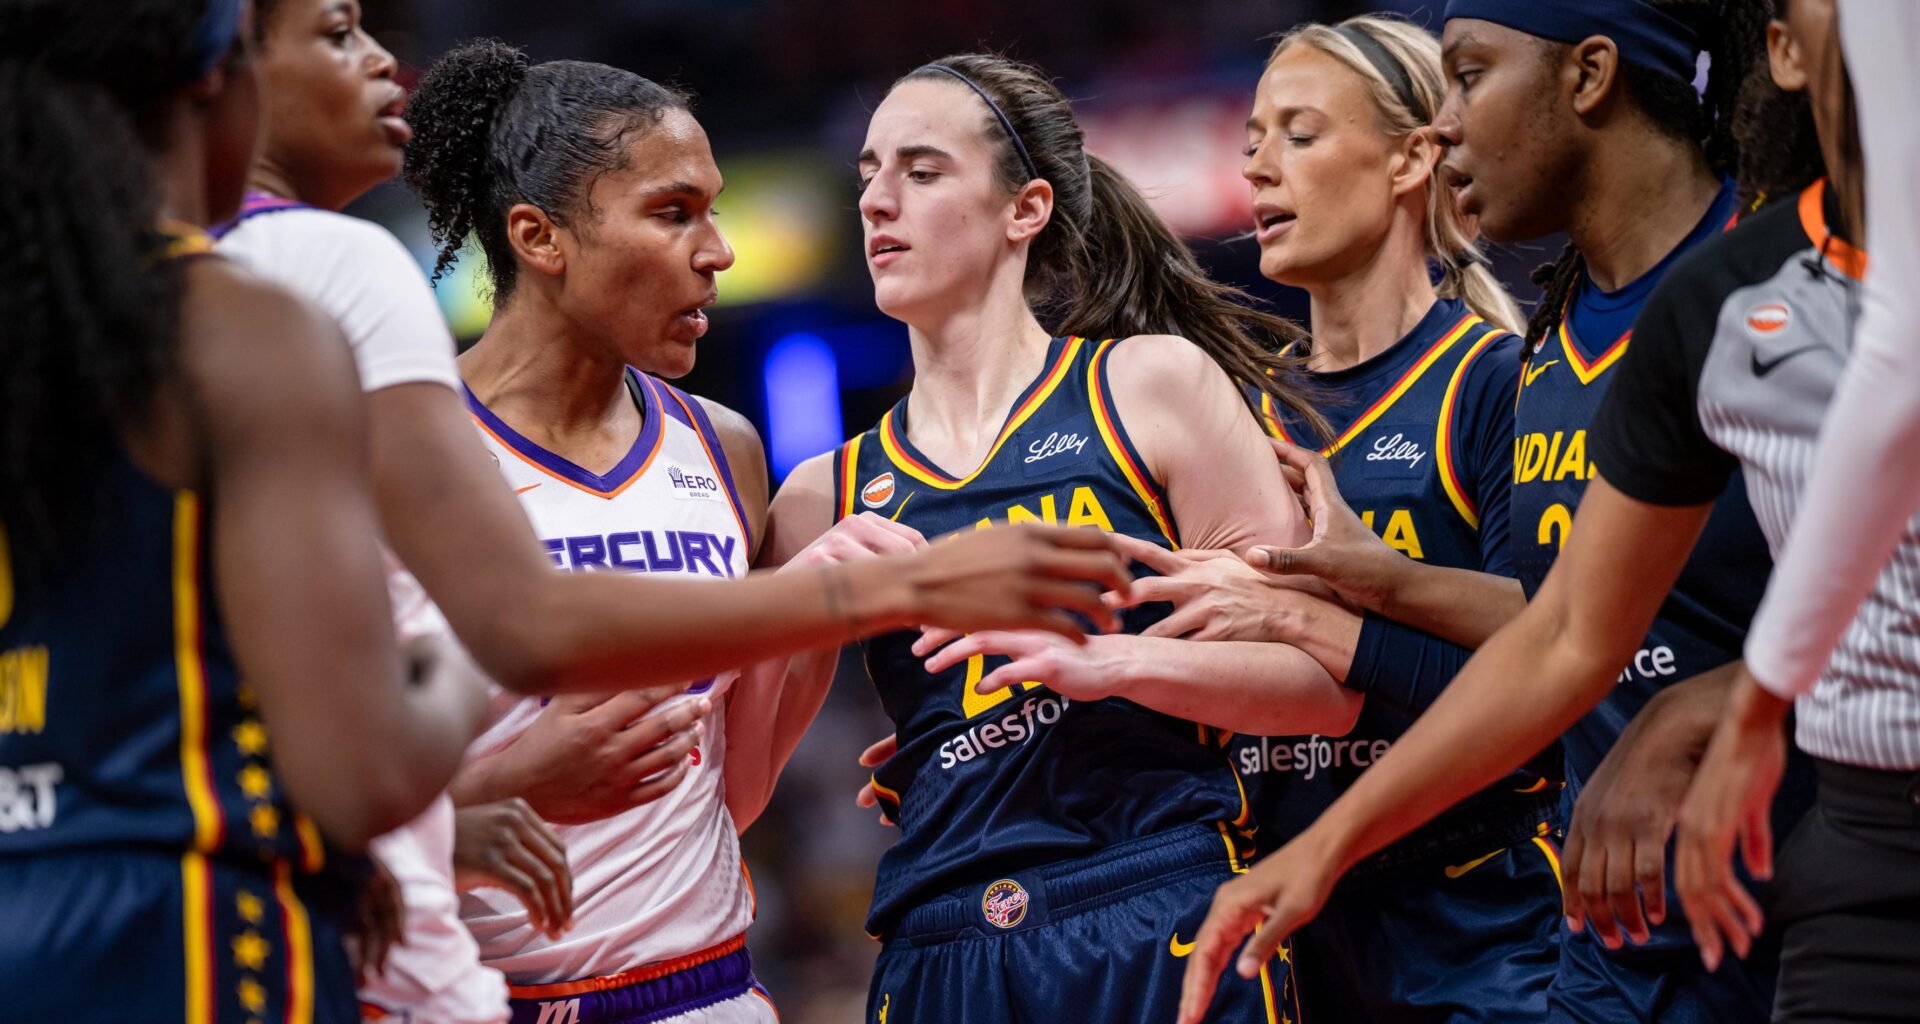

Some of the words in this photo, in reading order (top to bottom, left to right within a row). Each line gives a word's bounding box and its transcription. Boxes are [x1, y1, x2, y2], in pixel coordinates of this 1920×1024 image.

[1024, 432, 1089, 463] Lilly
[1366, 433, 1427, 469] Lilly
[1513, 430, 1598, 485] NDIA
[667, 471, 717, 491] HERO
[540, 530, 735, 580] ERCURY
[940, 697, 1070, 769] salesfo
[985, 889, 1030, 922] Fever
